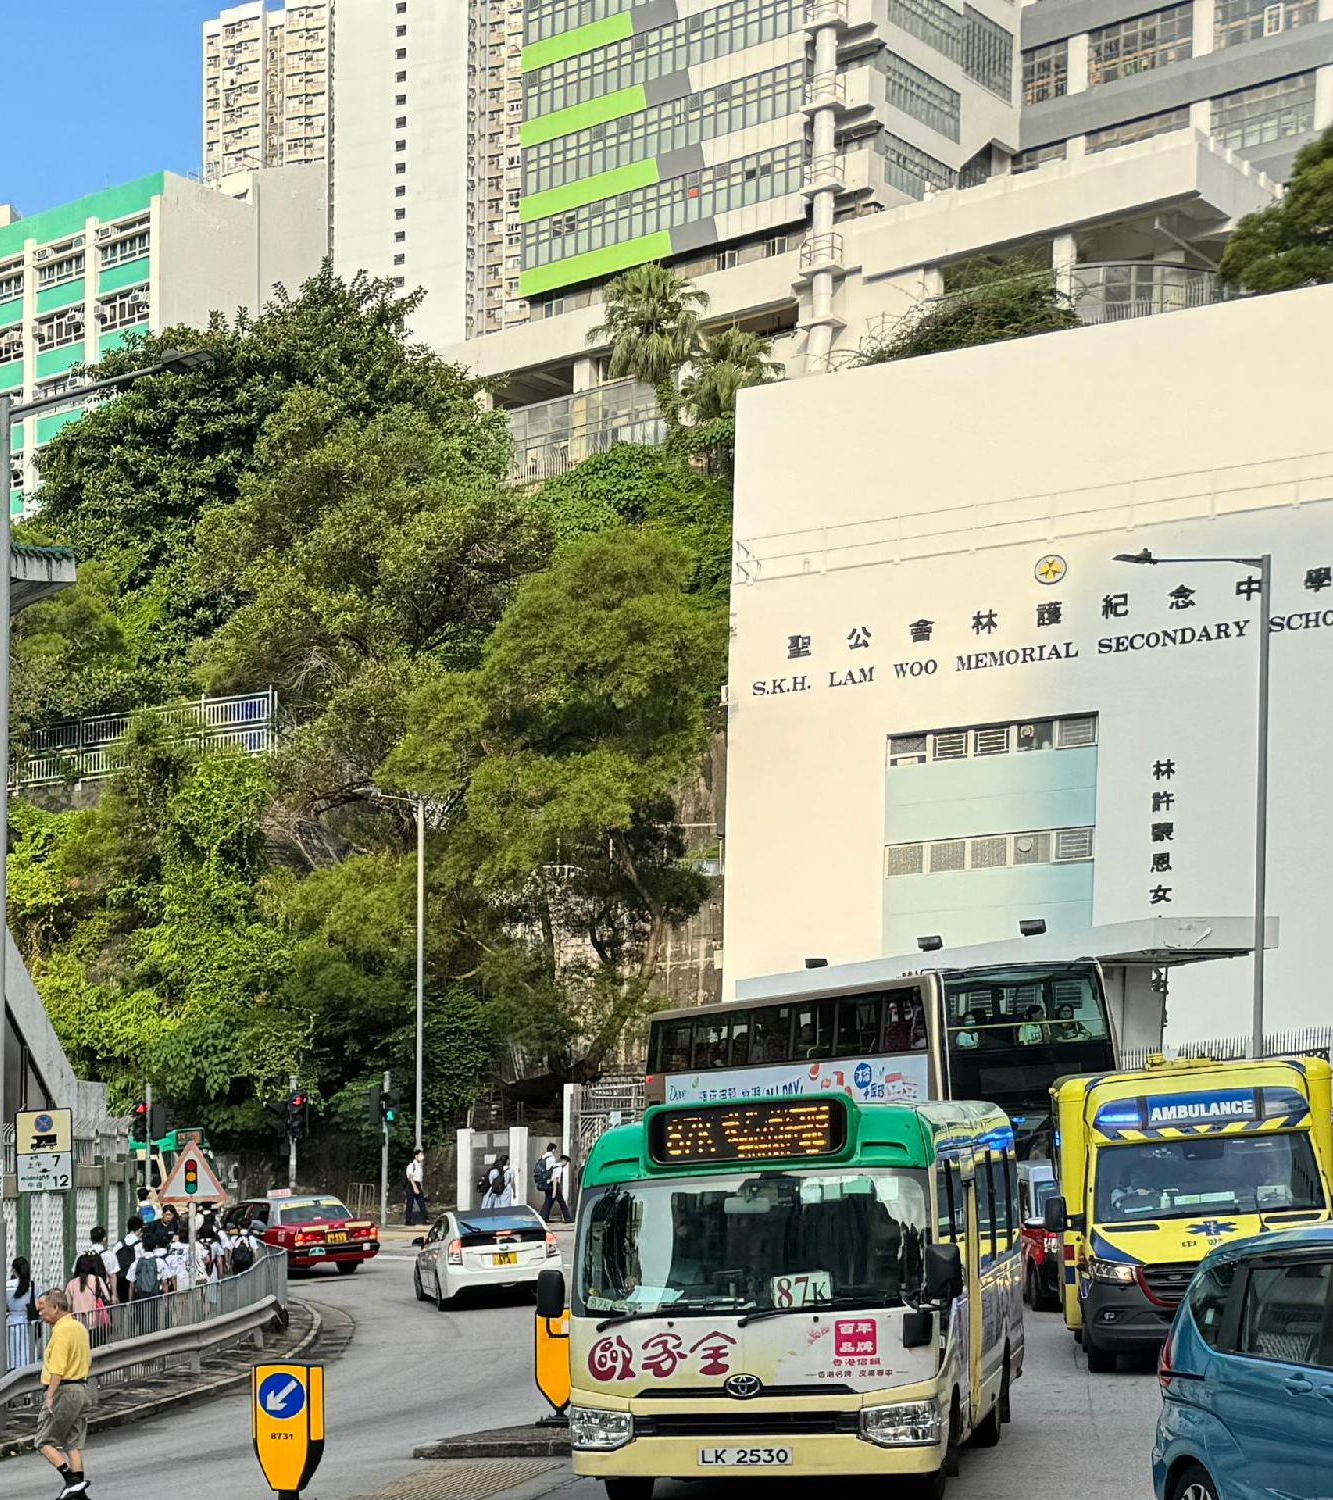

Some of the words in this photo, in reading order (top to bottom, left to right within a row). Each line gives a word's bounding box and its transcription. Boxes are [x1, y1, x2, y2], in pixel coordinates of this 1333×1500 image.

[787, 566, 1332, 659] 聖公會林護紀念中學
[752, 676, 811, 696] S.K.H.
[828, 666, 875, 688] LAM
[893, 659, 938, 679] WOO
[955, 642, 1079, 672] MEMORIAL
[1097, 620, 1250, 654] SECONDARY
[1148, 758, 1176, 918] 林許蒙恩女
[1151, 1099, 1254, 1121] AMBULANCE
[52, 1154, 61, 1167] 7
[52, 1174, 69, 1187] 12
[776, 1276, 827, 1308] 87K
[270, 1432, 293, 1440] 8731
[701, 1449, 727, 1465] LK
[736, 1448, 789, 1465] 2530
